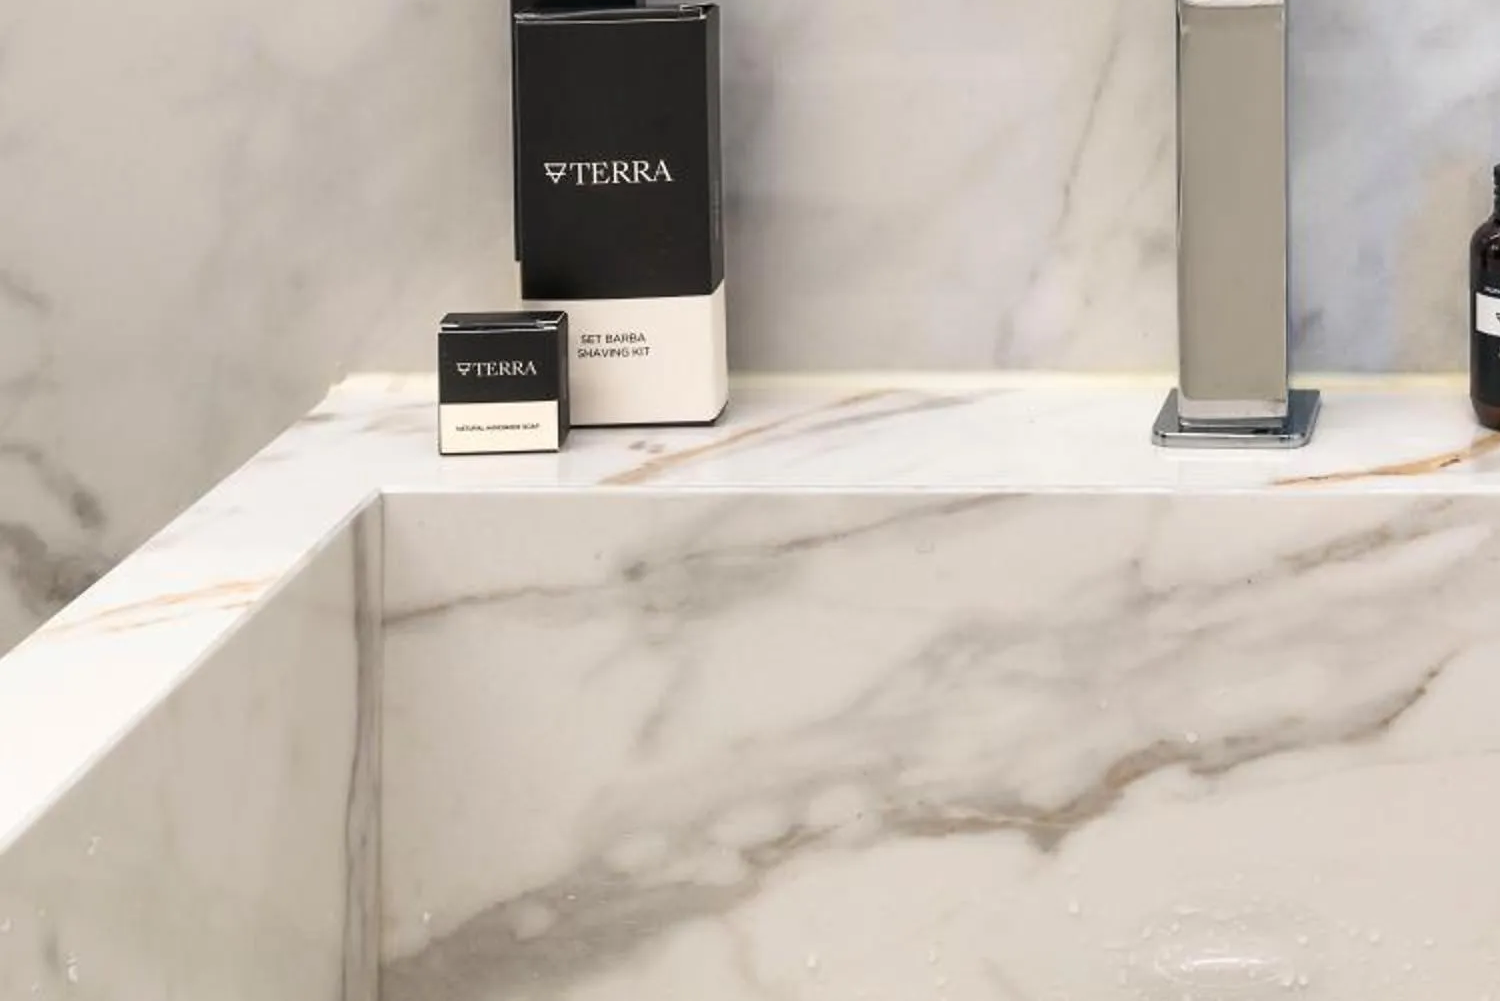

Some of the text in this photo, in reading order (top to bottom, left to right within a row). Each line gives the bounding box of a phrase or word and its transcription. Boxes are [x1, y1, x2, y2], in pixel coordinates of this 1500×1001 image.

[569, 158, 674, 186] TERRA
[580, 333, 646, 344] SET BARBA
[577, 346, 650, 359] SHAVING KIT
[472, 360, 538, 377] TERRA
